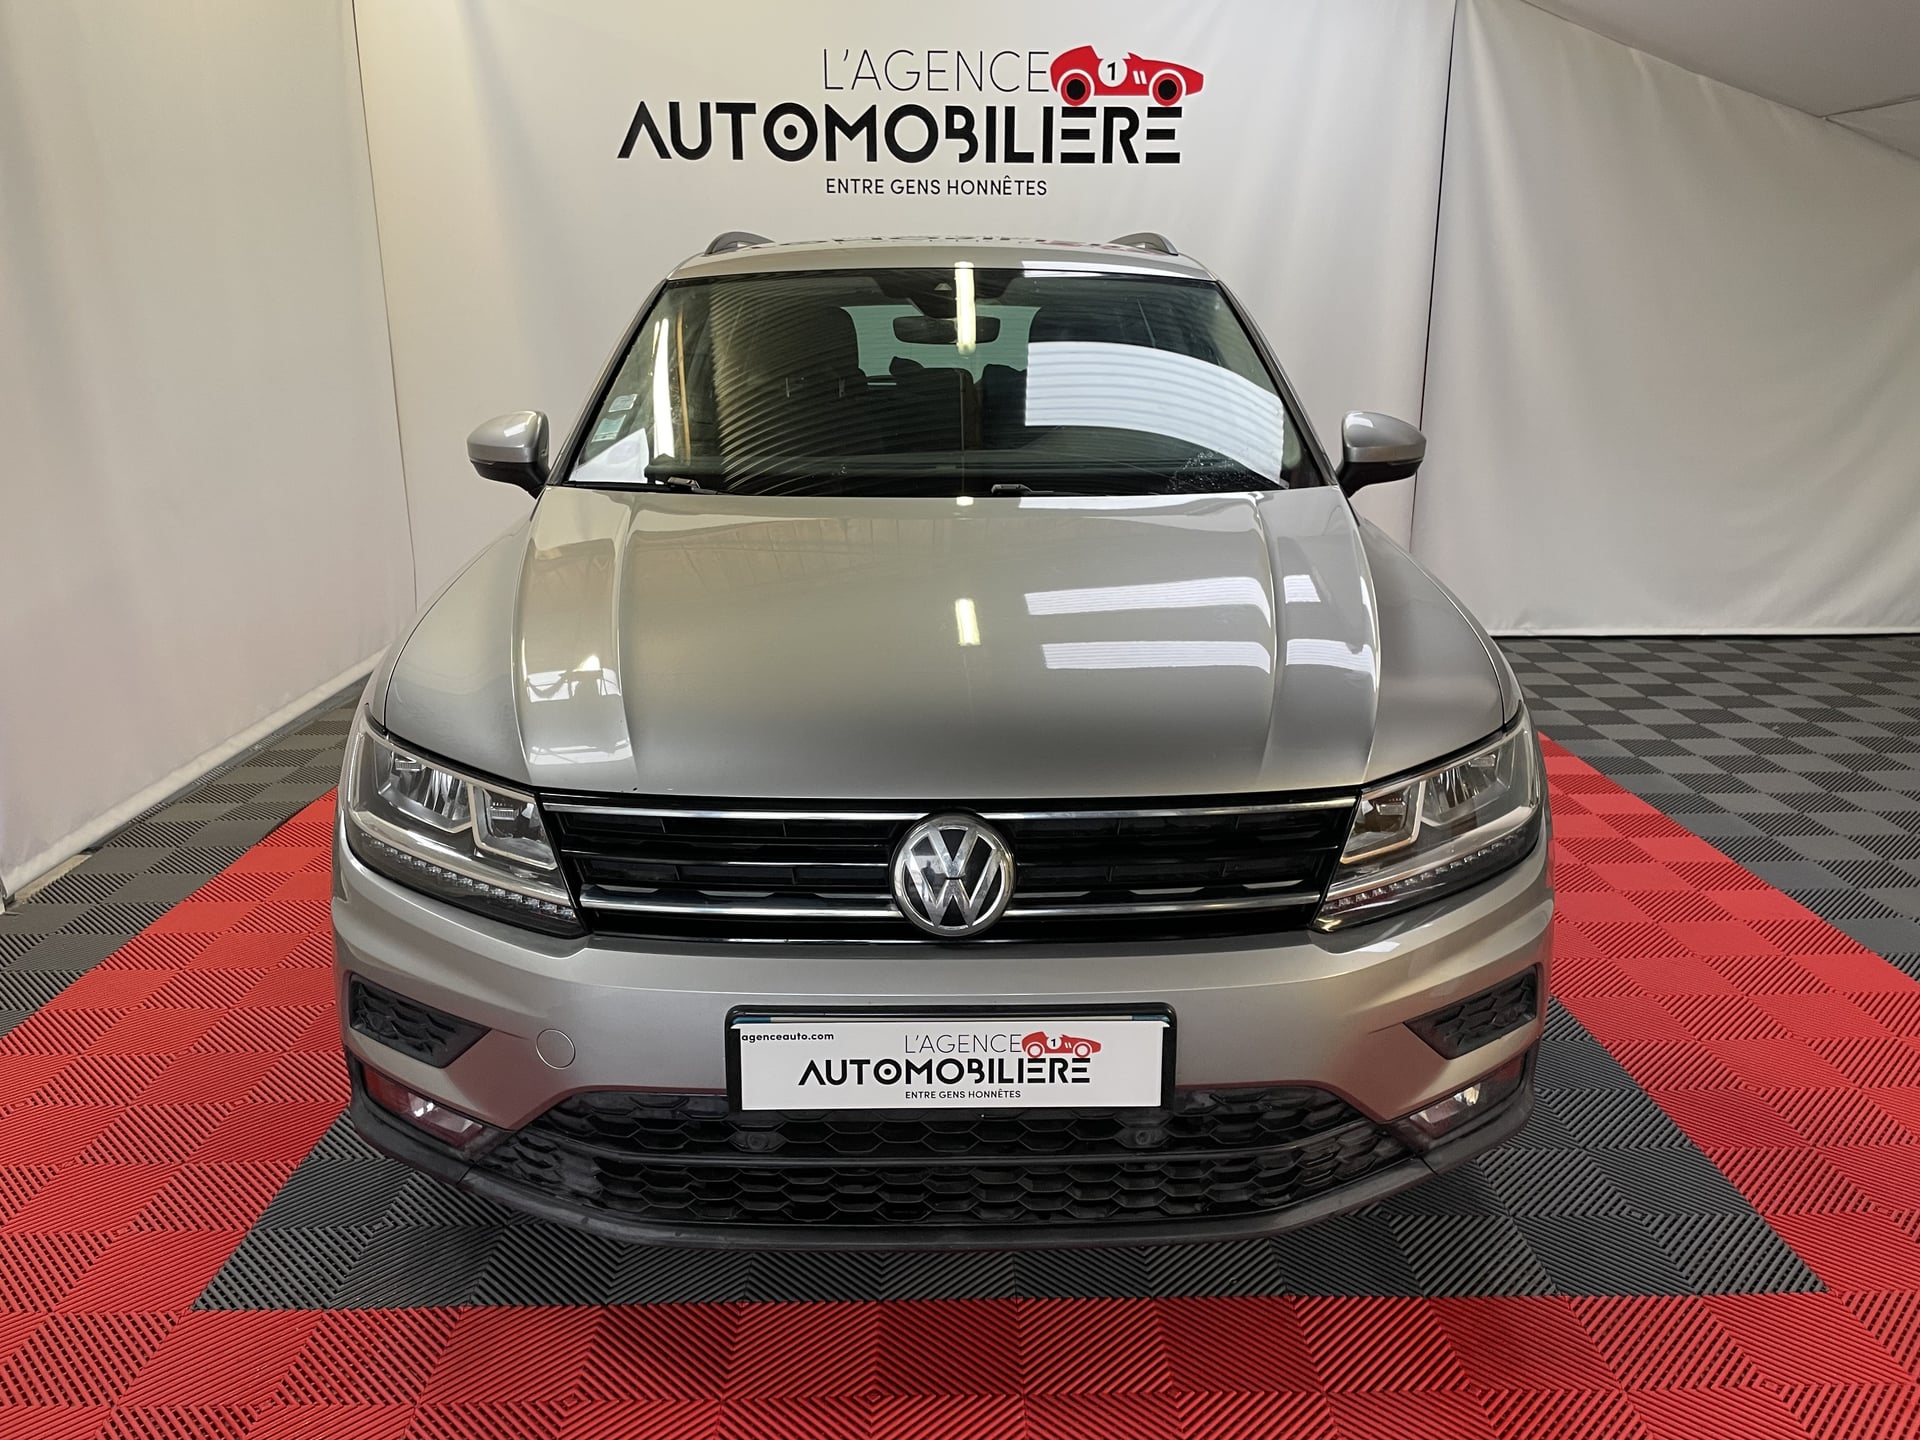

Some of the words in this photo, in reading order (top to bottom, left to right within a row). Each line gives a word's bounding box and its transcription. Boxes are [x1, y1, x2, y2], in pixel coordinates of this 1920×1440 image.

[823, 48, 1050, 93] L'AGENCE
[1106, 61, 1116, 81] 1
[826, 178, 885, 195] ENTRE
[890, 178, 941, 195] GENS
[947, 175, 1047, 196] HONNÊTES
[741, 1032, 835, 1044] agenceauto.com
[905, 1033, 1022, 1054] L'AGENCE
[905, 1090, 936, 1100] ENTRE
[938, 1090, 966, 1099] GENS
[968, 1088, 1021, 1099] HONNÊTES
